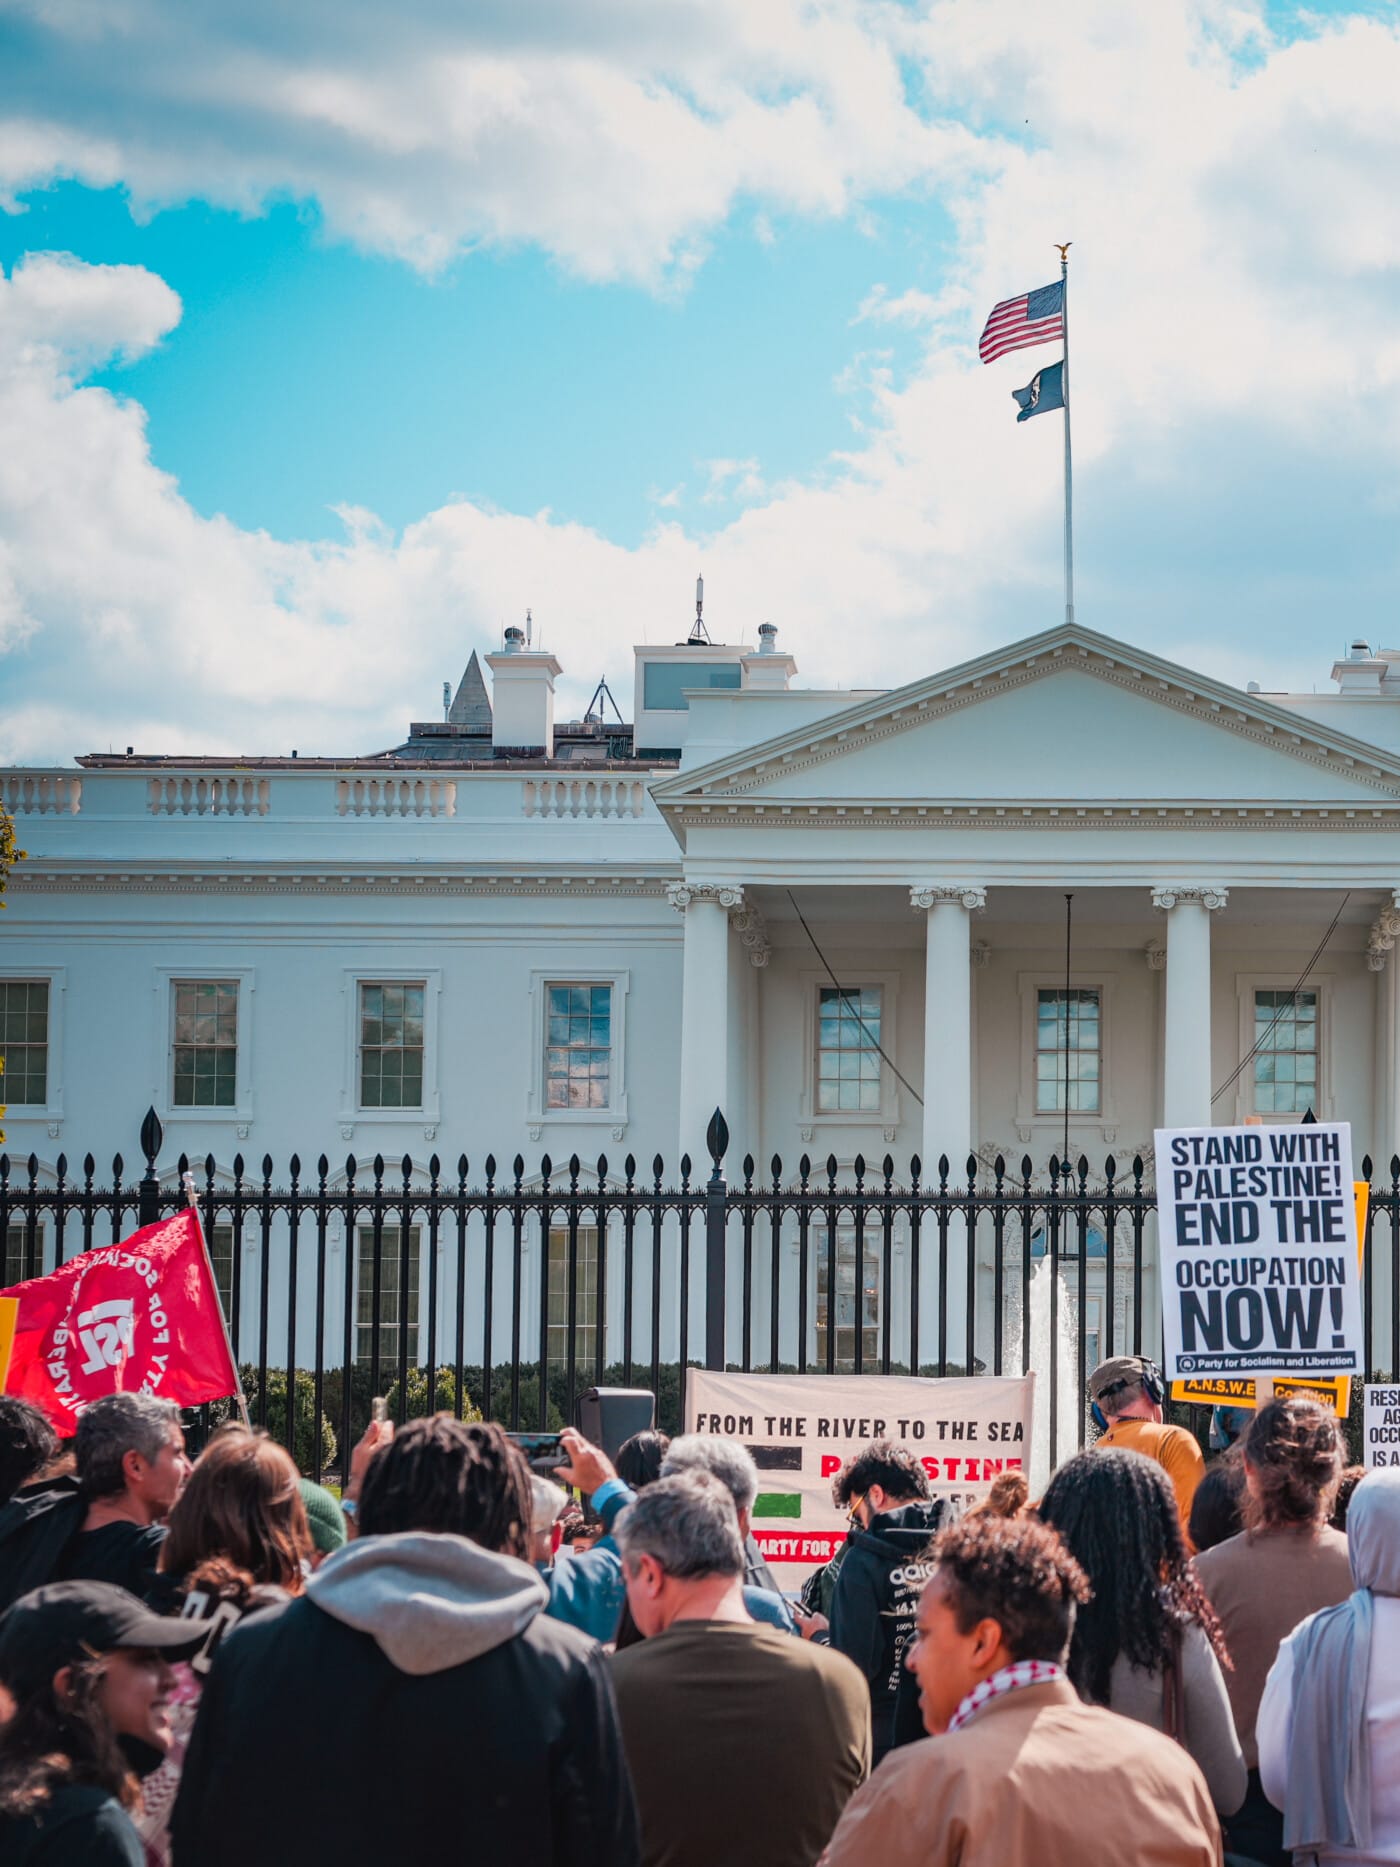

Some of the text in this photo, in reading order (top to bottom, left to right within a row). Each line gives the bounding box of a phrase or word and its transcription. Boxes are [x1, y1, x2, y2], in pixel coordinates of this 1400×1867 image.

[1172, 1133, 1339, 1166] STAND WITH
[1173, 1165, 1342, 1200] PALESTINE!
[1175, 1200, 1346, 1246] END THE
[1176, 1257, 1346, 1288] OCCUPATION
[1180, 1288, 1346, 1352] NOW!
[1198, 1356, 1353, 1369] Party for Socialism and Liberation
[696, 1413, 1024, 1441] FROM THE RIVER TO THE SEA
[1373, 1451, 1386, 1466] IS
[1390, 1451, 1400, 1466] A
[802, 1540, 830, 1556] FOR
